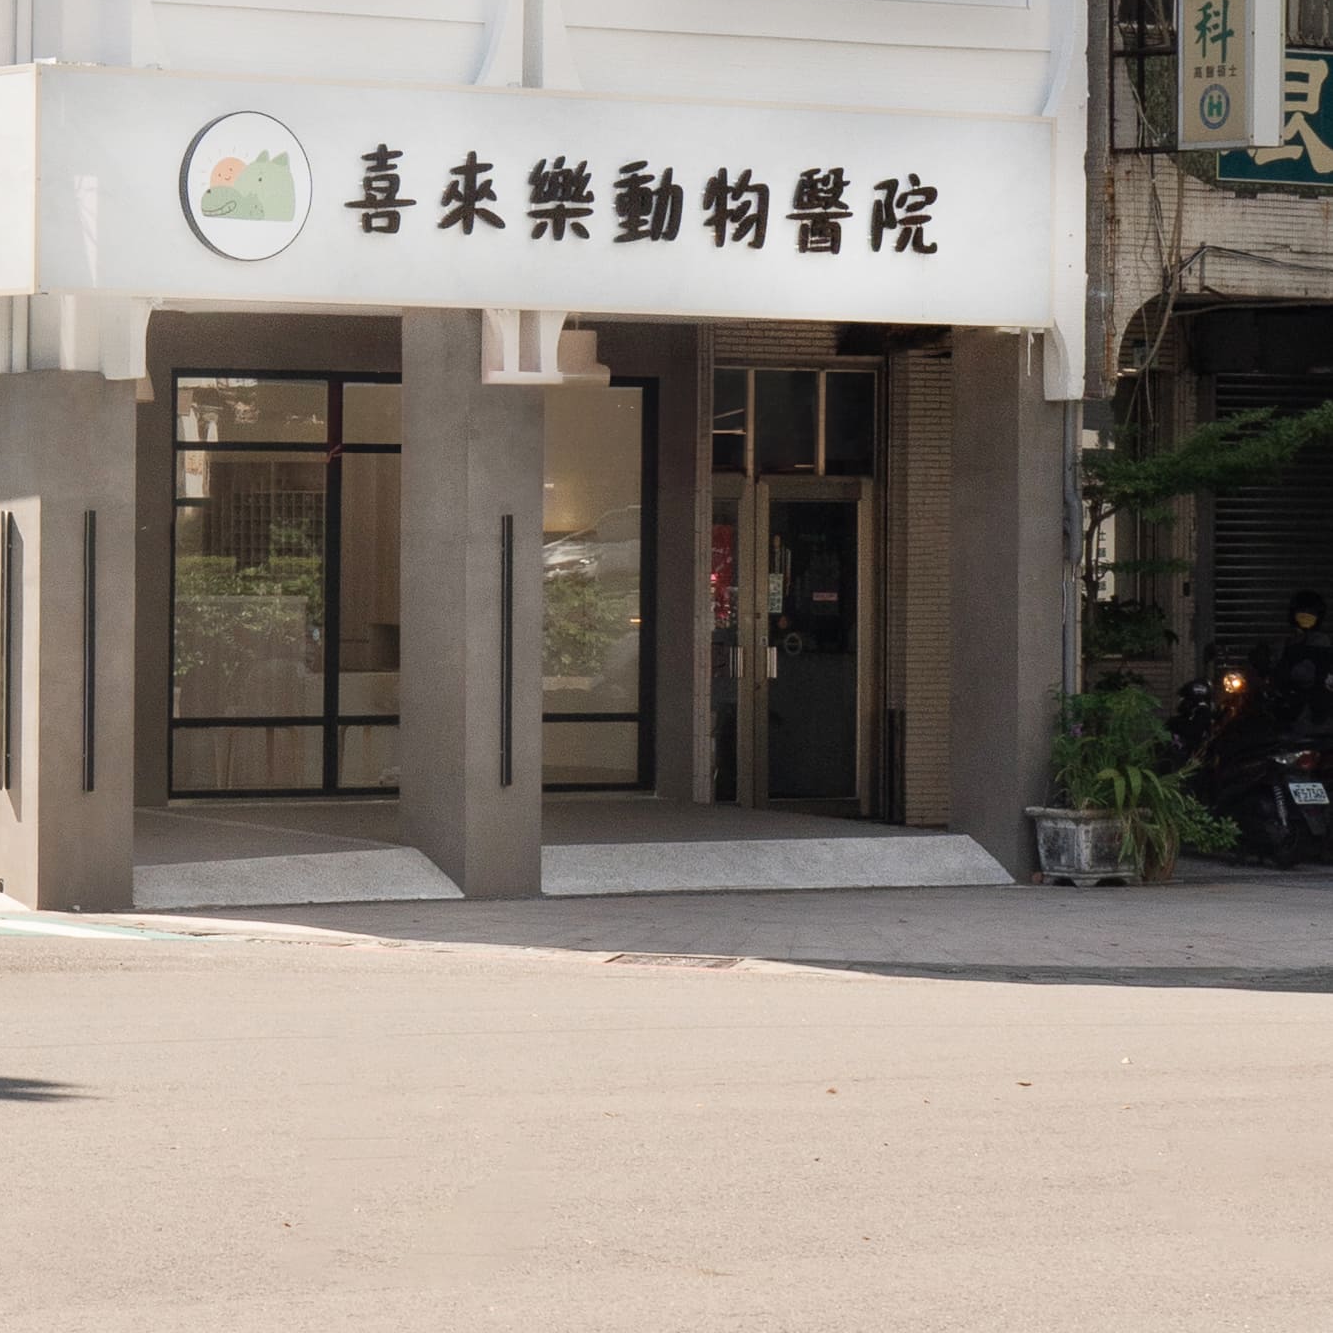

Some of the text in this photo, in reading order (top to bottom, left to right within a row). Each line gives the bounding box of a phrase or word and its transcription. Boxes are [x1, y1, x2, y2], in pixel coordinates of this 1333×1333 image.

[344, 144, 938, 255] 喜來樂動物醫院
